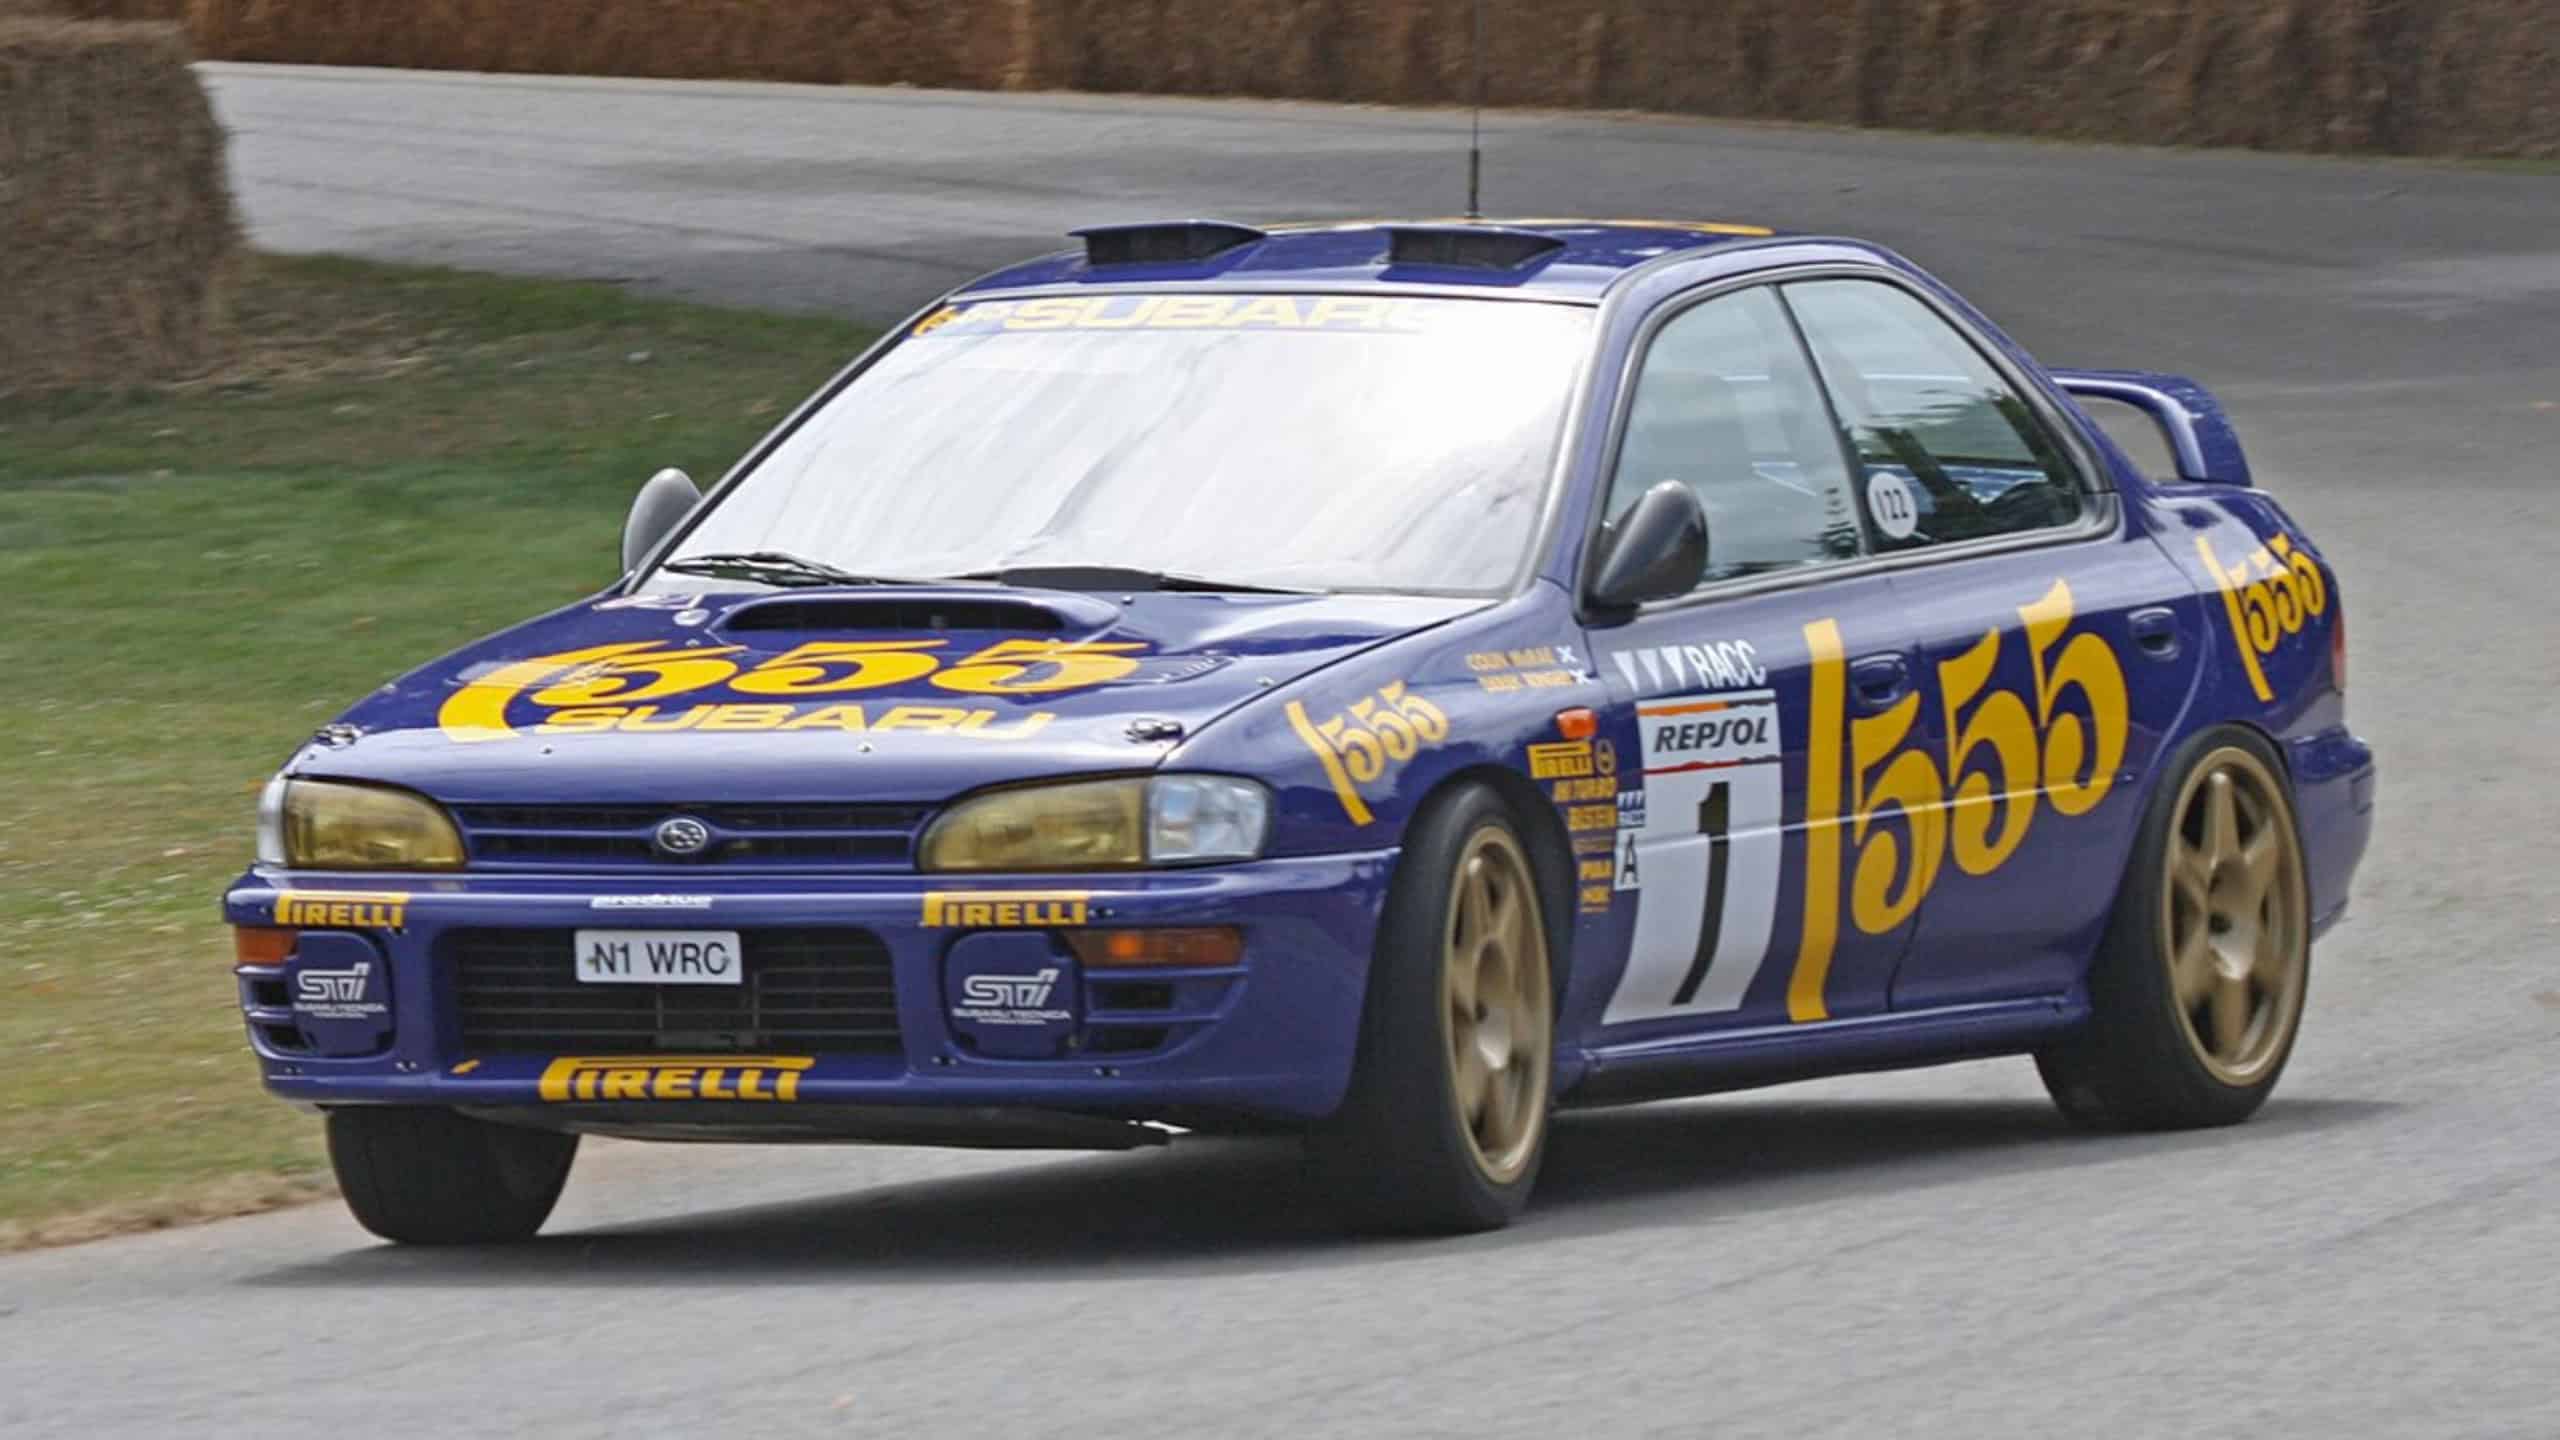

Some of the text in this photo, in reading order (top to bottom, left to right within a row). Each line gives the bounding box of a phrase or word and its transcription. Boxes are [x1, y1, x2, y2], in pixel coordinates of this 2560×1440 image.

[1688, 640, 1767, 690] RACC
[535, 704, 1056, 738] SUBARU
[1655, 717, 1769, 753] REPSOL
[1620, 833, 1639, 886] A
[275, 891, 409, 927] PIRELLI
[922, 892, 1089, 927] PIRELLI
[1671, 781, 1729, 1005] 1
[593, 940, 731, 975] N1 WRC
[538, 1058, 815, 1101] PIRELLI
